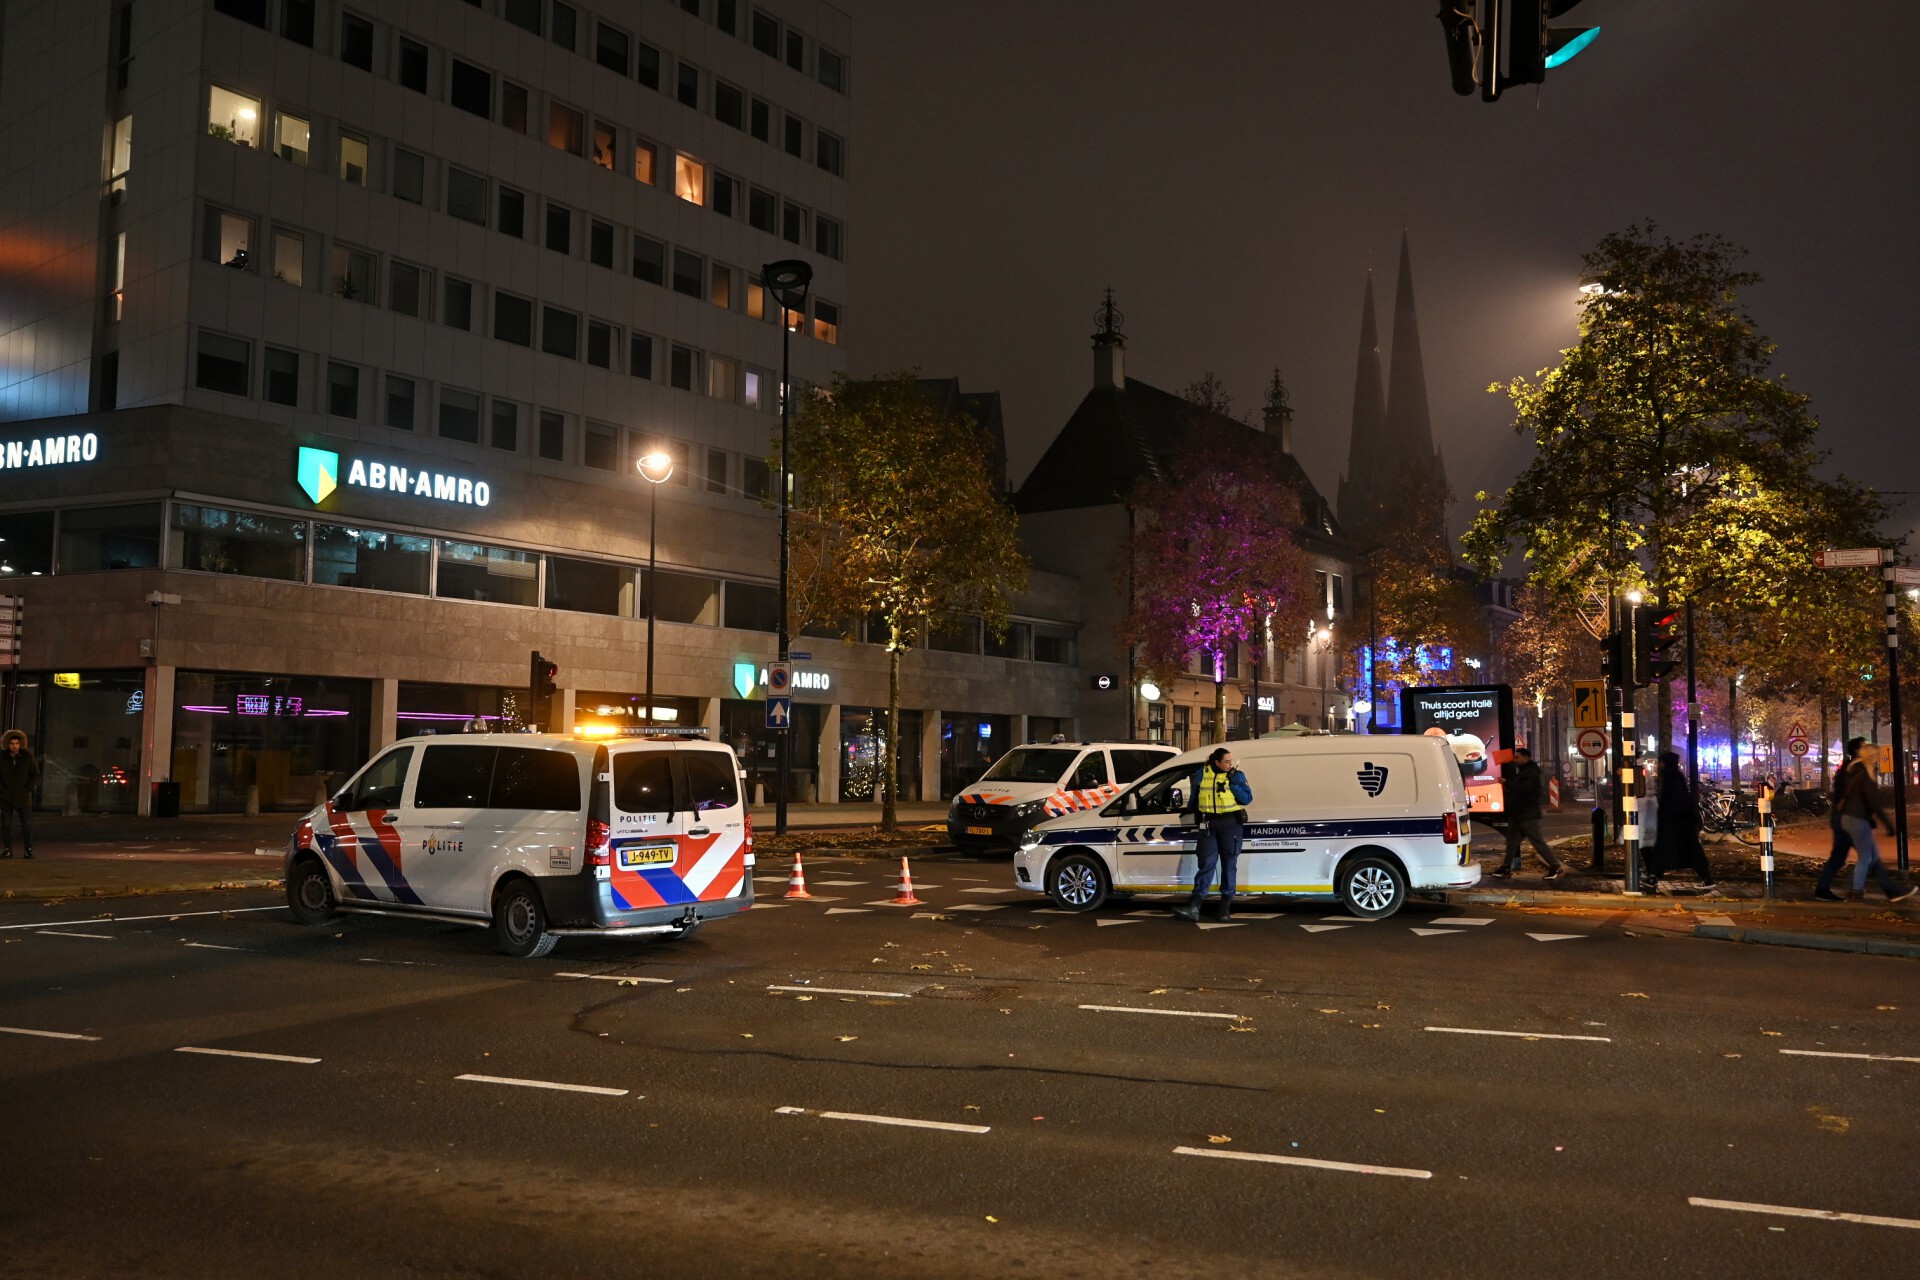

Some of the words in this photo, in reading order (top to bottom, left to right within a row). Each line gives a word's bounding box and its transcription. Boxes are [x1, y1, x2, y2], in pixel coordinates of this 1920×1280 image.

[1420, 701, 1441, 710] Thuis
[1442, 700, 1470, 709] scoort
[1471, 699, 1493, 708] Italië
[1433, 710, 1455, 720] altijd
[1455, 709, 1479, 720] goed
[620, 815, 657, 823] POLITIE
[1251, 827, 1306, 835] HANDHAVING
[422, 839, 464, 855] POLITIE
[632, 850, 669, 862] J-949-TV
